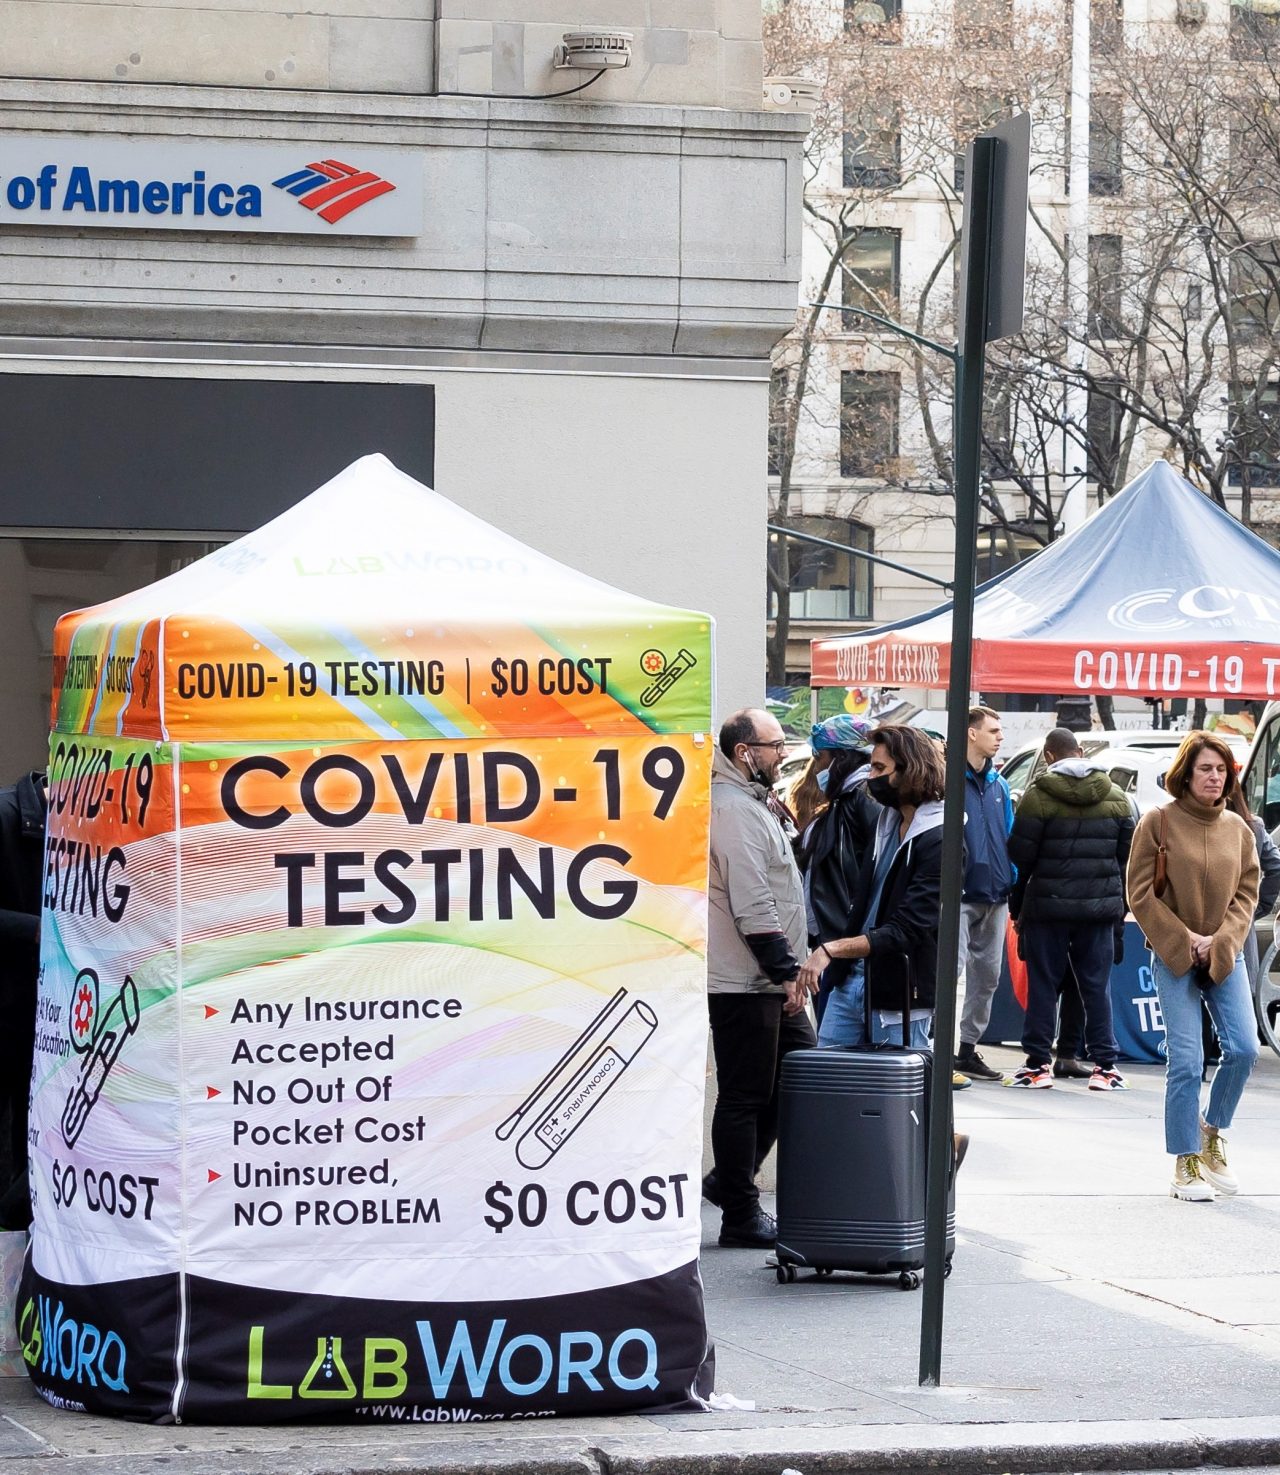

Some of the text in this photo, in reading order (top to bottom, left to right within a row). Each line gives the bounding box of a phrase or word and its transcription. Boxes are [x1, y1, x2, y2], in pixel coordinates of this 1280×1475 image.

[6, 165, 262, 217] of America
[177, 656, 612, 700] COVID-19 TESTING $0 COST
[836, 643, 940, 684] COVID-19 TESTING
[1073, 650, 1244, 694] COVID-19
[49, 741, 154, 828] COVID-19
[221, 745, 686, 830] COVID-19
[274, 843, 639, 928] TESTING
[230, 996, 462, 1029] Any Insurance
[231, 1034, 394, 1069] Accepted
[233, 1075, 393, 1105] No Out Of
[562, 1057, 616, 1120] CORONAVIRUS
[233, 1115, 426, 1146] Pocket Cost
[52, 1159, 160, 1222] $0 COST
[233, 1158, 398, 1188] Uninsured,
[234, 1198, 441, 1227] NO PROBLEM
[484, 1172, 690, 1234] $0 COST
